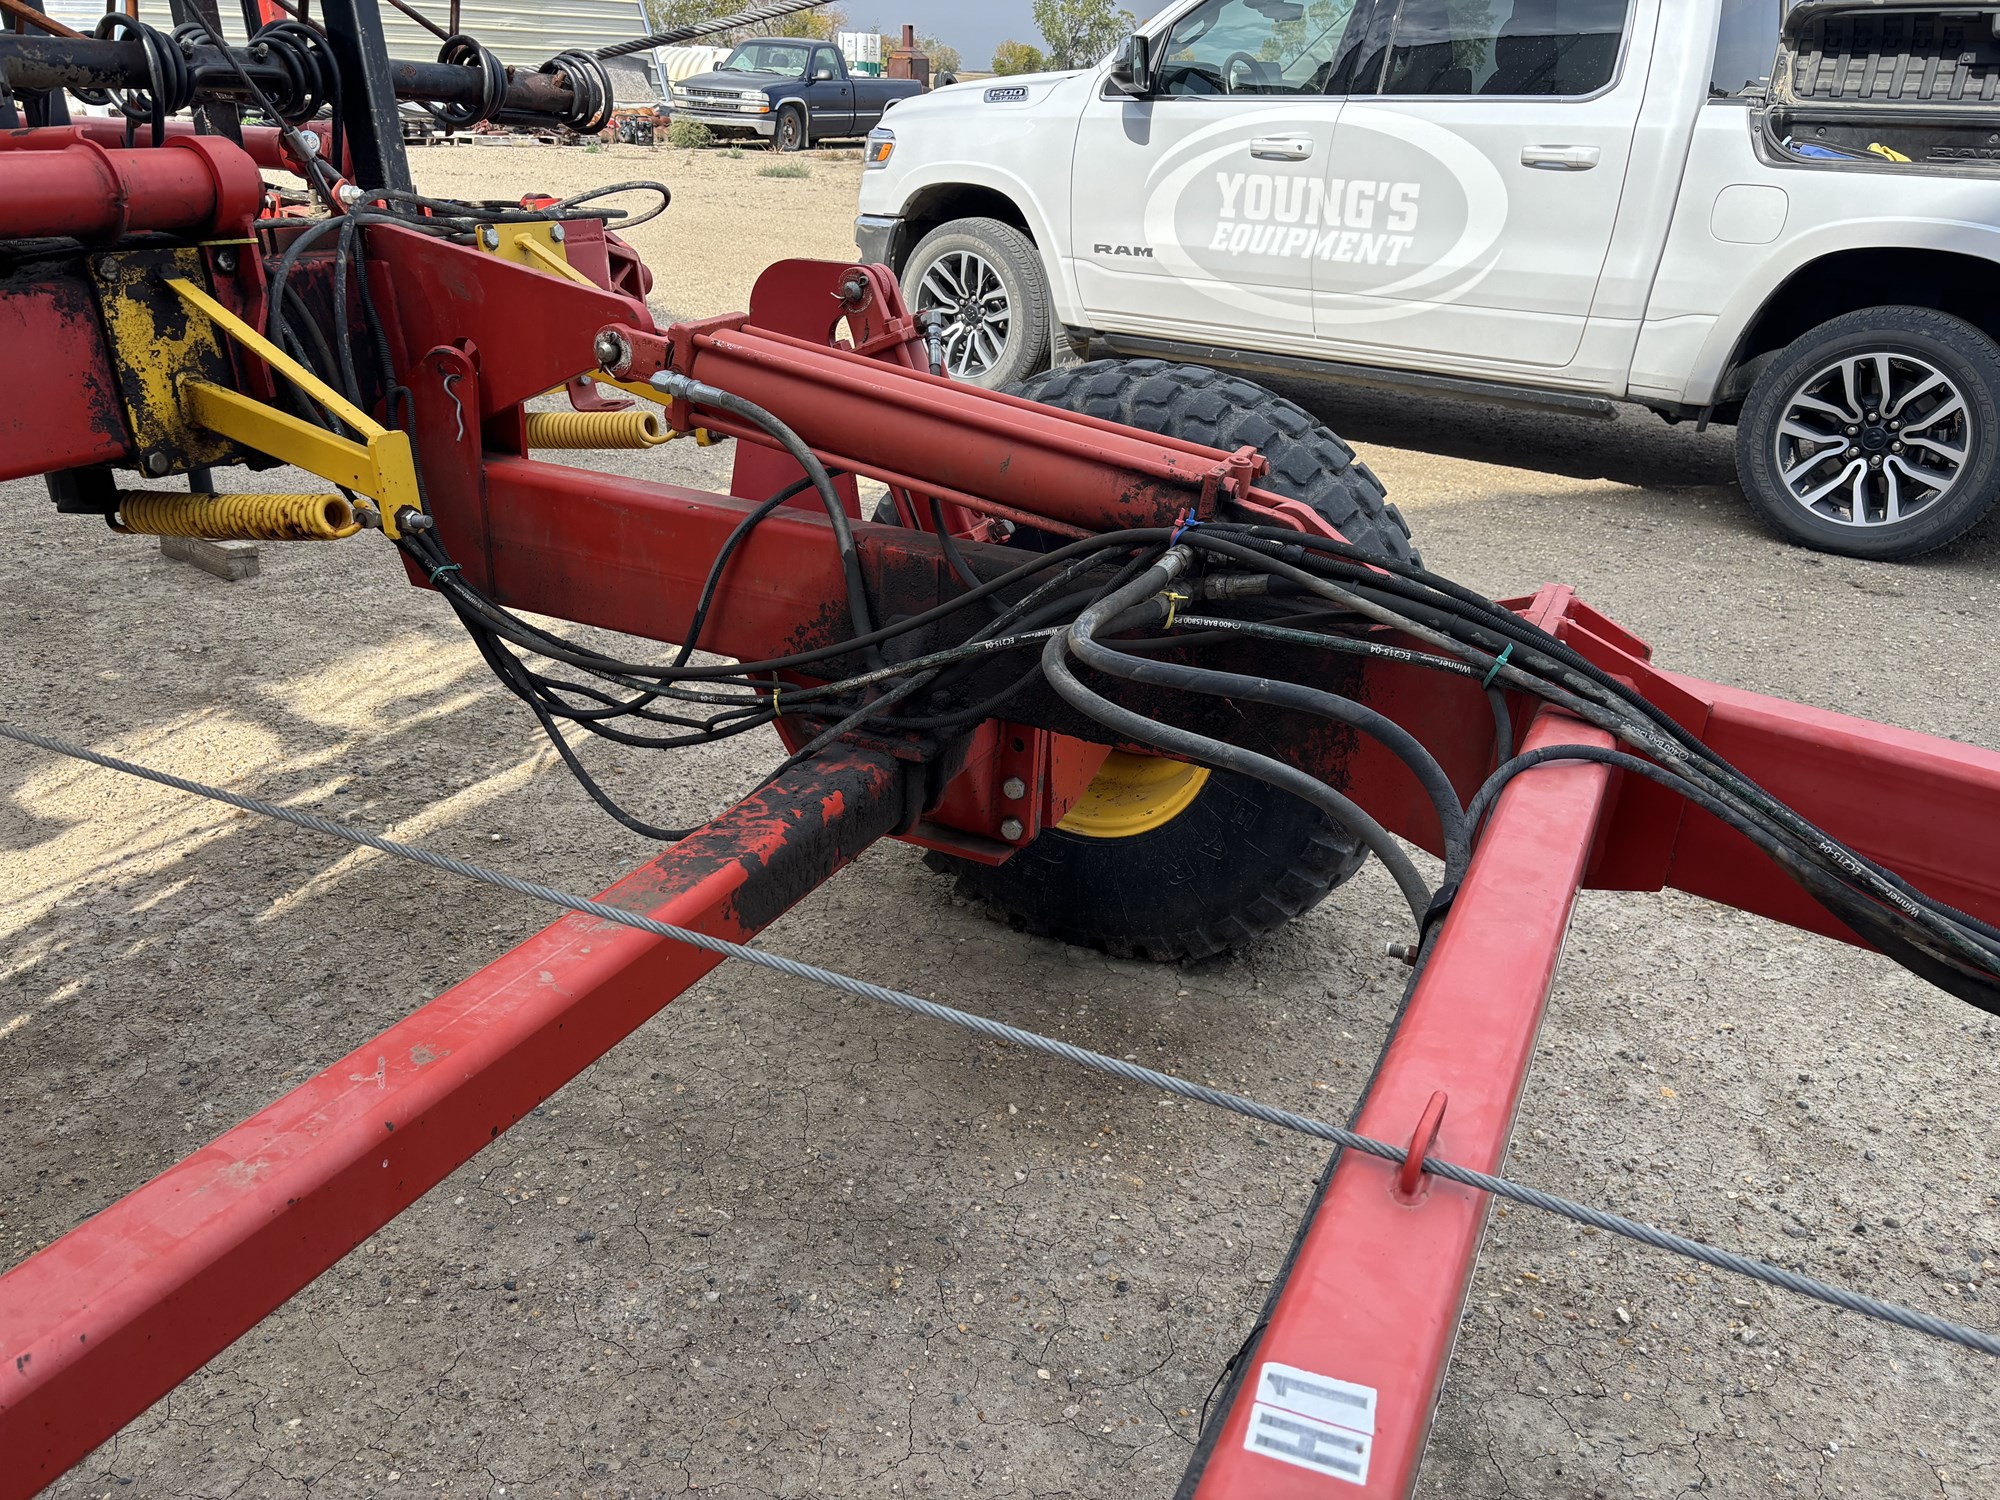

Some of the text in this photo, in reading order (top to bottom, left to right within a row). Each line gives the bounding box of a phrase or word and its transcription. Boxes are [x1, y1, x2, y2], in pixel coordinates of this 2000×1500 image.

[991, 89, 1024, 97] 1500
[1216, 172, 1421, 232] YOUNG'S
[1093, 243, 1154, 258] RAM
[1208, 219, 1415, 267] EQUIPMENT
[1957, 364, 1998, 484] DUELER
[1204, 619, 1218, 627] BAR
[1034, 627, 1059, 638] Winner
[1370, 644, 1411, 661] EC215-04
[1438, 658, 1471, 674] Winner
[1818, 840, 1920, 917] Winner EC215-04
